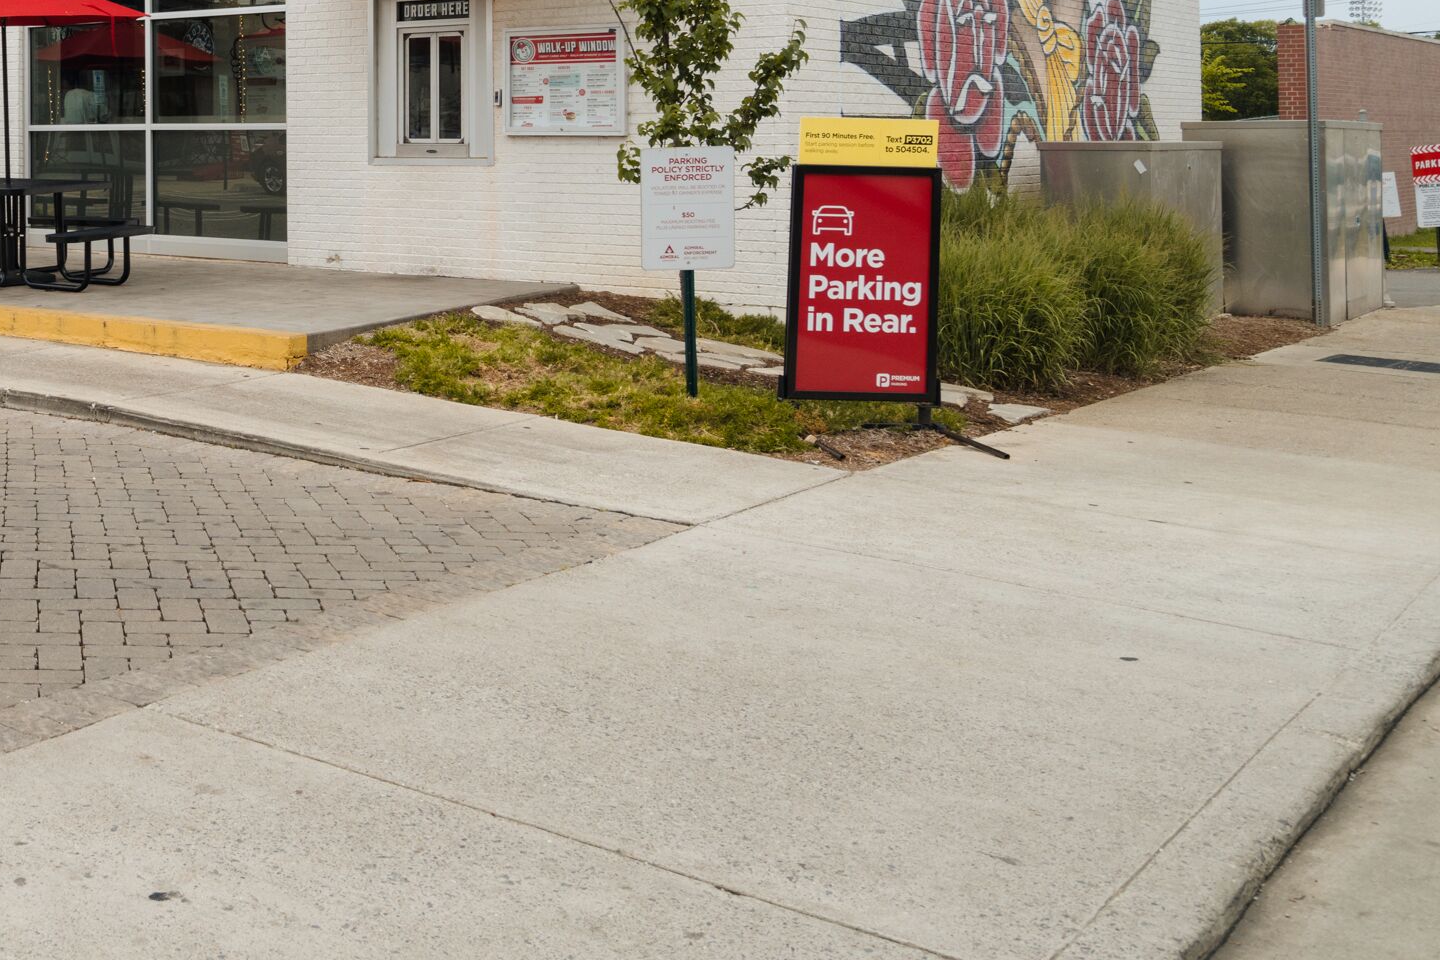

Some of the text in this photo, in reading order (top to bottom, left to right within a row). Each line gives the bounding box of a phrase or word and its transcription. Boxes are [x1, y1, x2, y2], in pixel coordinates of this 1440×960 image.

[404, 1, 469, 17] ORDER HERE
[537, 40, 616, 53] WALK-UP WINDOW
[886, 135, 932, 145] Text P3702
[669, 157, 707, 165] PARKING
[651, 165, 725, 174] POLICY STRICTLY
[664, 173, 712, 182] ENFORCED
[809, 242, 886, 269] More
[808, 274, 922, 307] Parking
[806, 306, 917, 334] in Rear.
